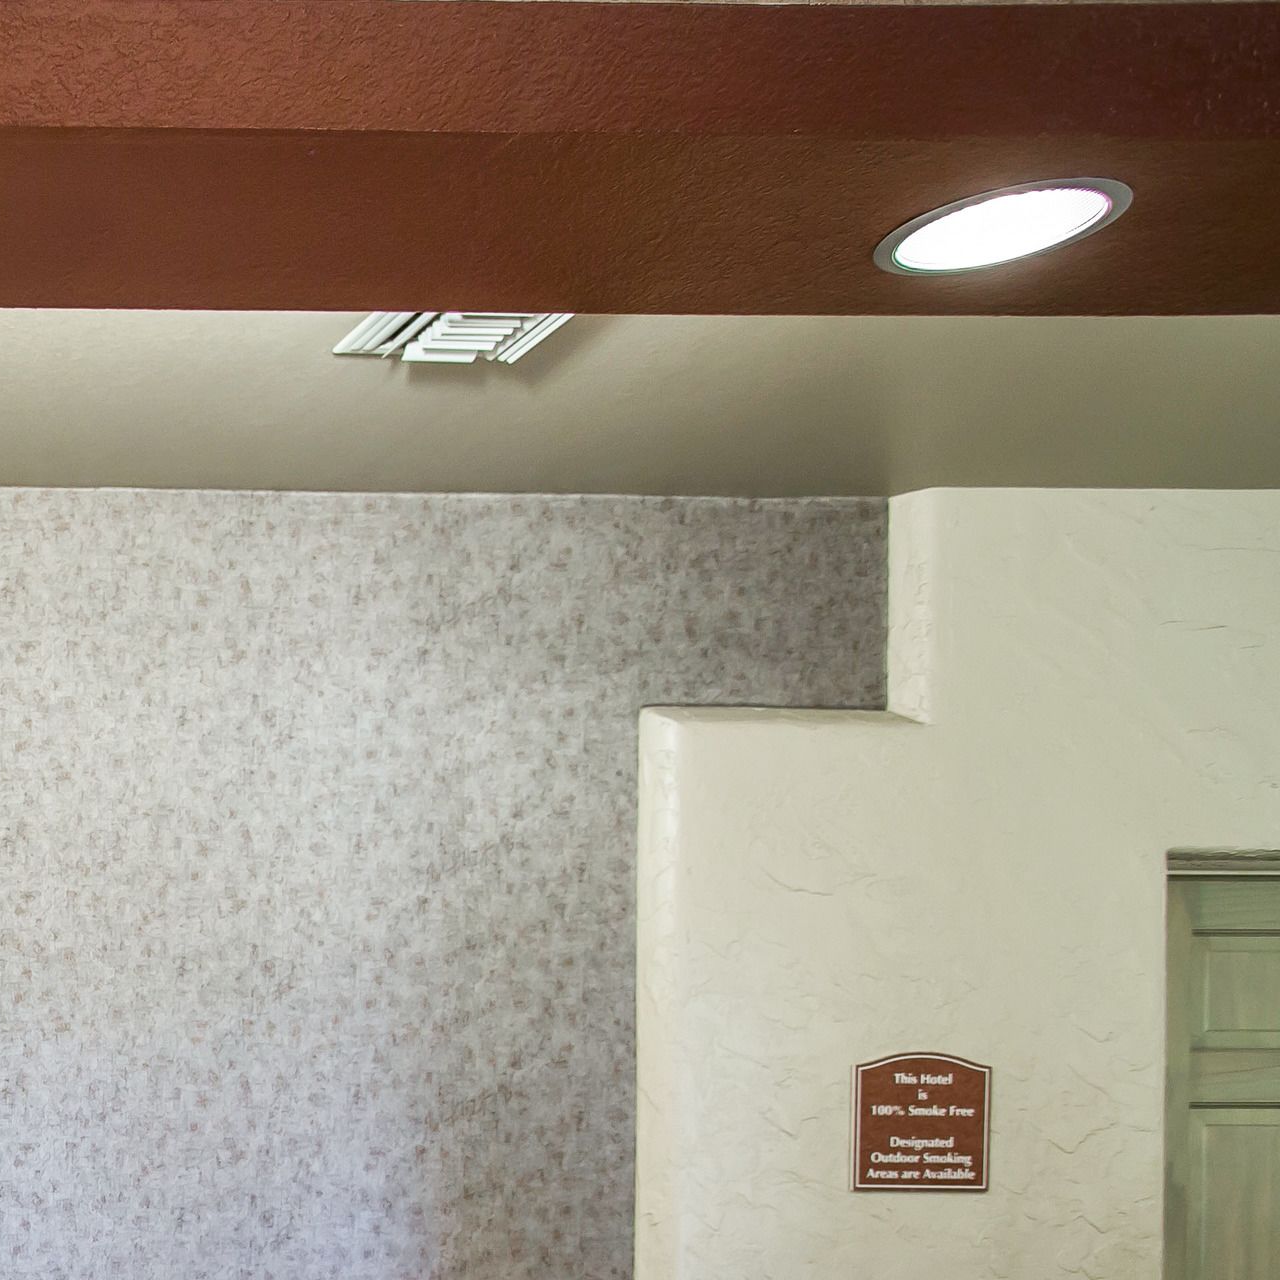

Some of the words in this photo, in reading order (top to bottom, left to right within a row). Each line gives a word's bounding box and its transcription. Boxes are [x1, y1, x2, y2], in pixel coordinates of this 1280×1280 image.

[893, 1073, 918, 1085] This
[920, 1073, 954, 1085] Hotel
[917, 1089, 928, 1100] is
[870, 1105, 906, 1116] 100%
[908, 1105, 947, 1116] Smoke
[949, 1105, 976, 1117] Free
[889, 1136, 955, 1150] Designated
[870, 1152, 920, 1163] Outdoor
[923, 1152, 973, 1166] Smoking
[866, 1168, 899, 1179] Areas
[901, 1170, 920, 1179] are
[922, 1168, 976, 1180] Available
